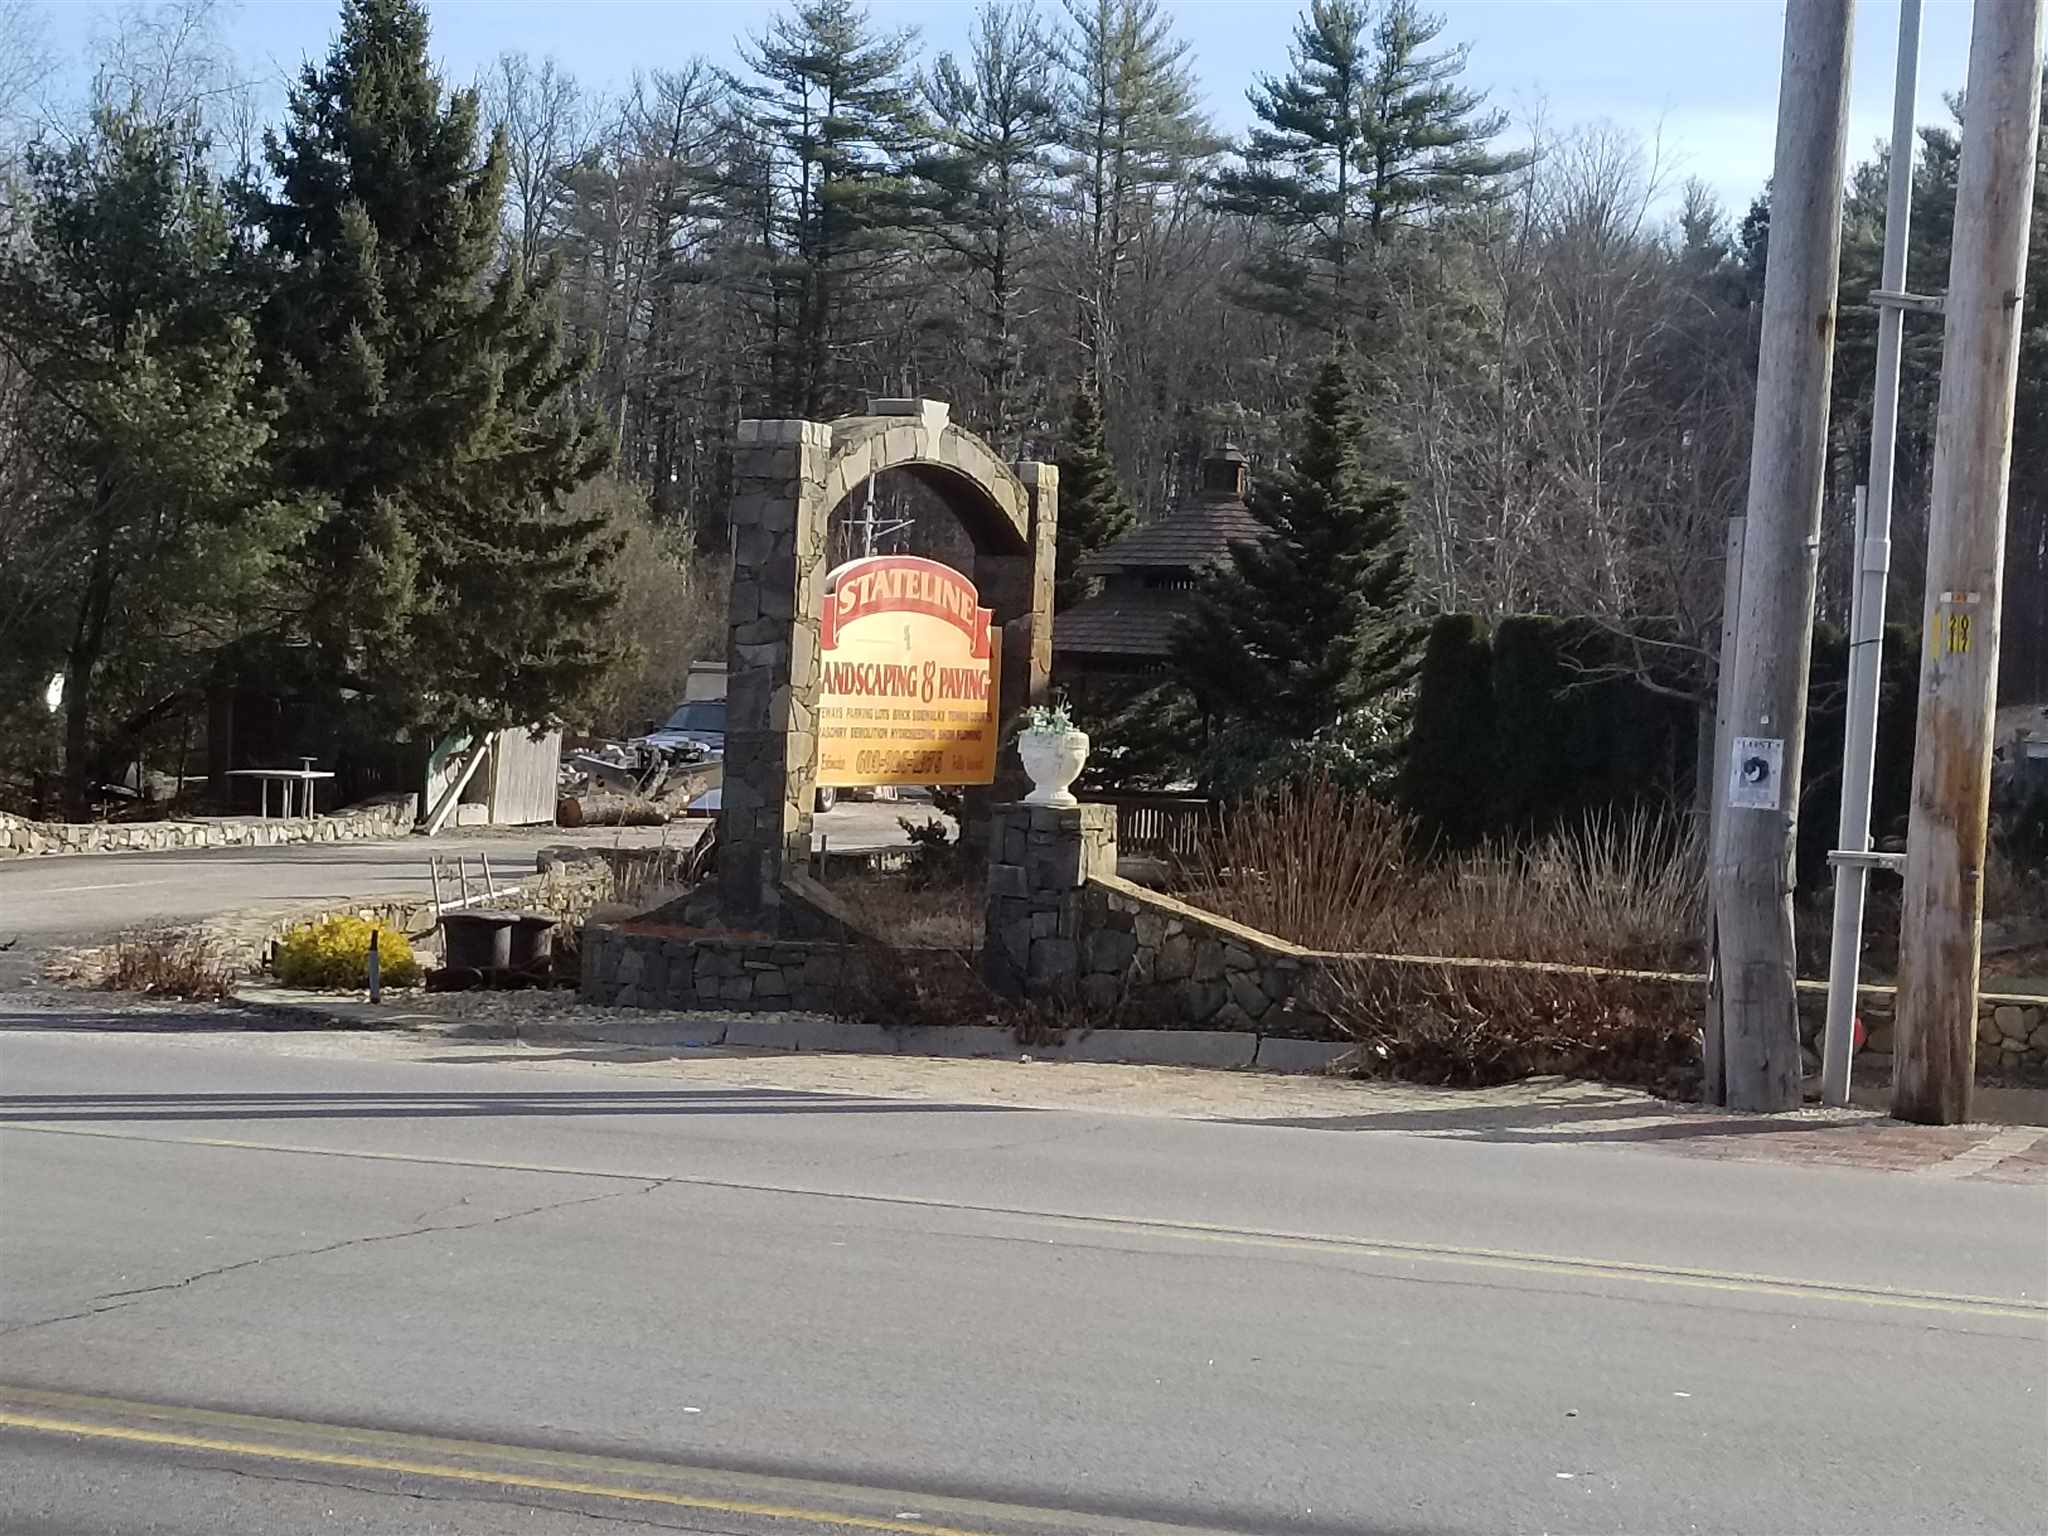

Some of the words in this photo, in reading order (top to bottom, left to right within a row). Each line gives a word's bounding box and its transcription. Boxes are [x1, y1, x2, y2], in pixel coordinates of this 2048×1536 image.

[838, 568, 975, 626] STATELINE
[822, 661, 918, 698] ANDSCAPING
[939, 668, 989, 700] PAVING
[850, 727, 888, 739] DEMOLITION
[1742, 740, 1772, 749] LOST
